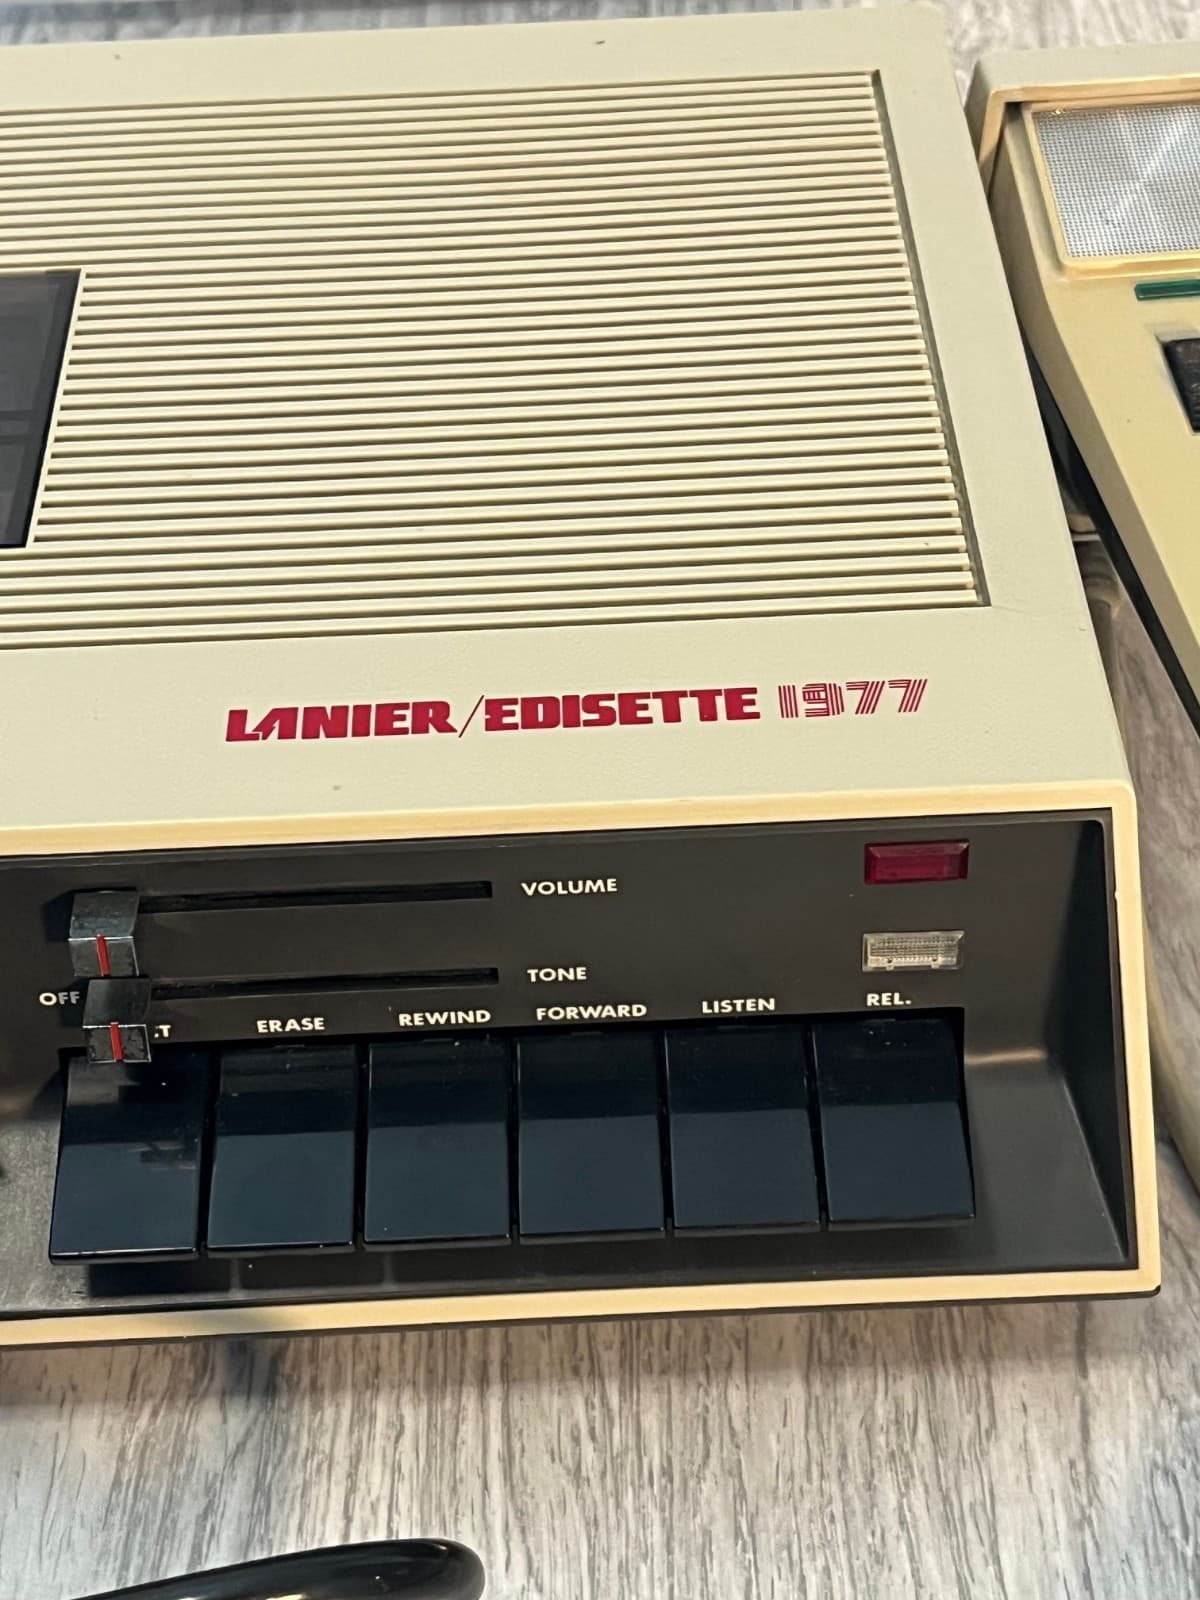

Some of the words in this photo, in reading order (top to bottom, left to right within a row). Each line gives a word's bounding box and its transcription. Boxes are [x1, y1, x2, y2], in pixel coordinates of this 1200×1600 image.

[226, 687, 761, 743] LANIER/EDISETTE
[778, 679, 928, 718] 1977
[520, 878, 619, 897] VOLUME
[526, 966, 588, 983] TONE
[39, 991, 80, 1006] OFF
[701, 997, 776, 1014] LISTEN
[866, 992, 912, 1007] REL.
[398, 1008, 492, 1027] REWIND
[536, 1003, 648, 1021] FORWARD
[256, 1016, 325, 1034] ERASE
